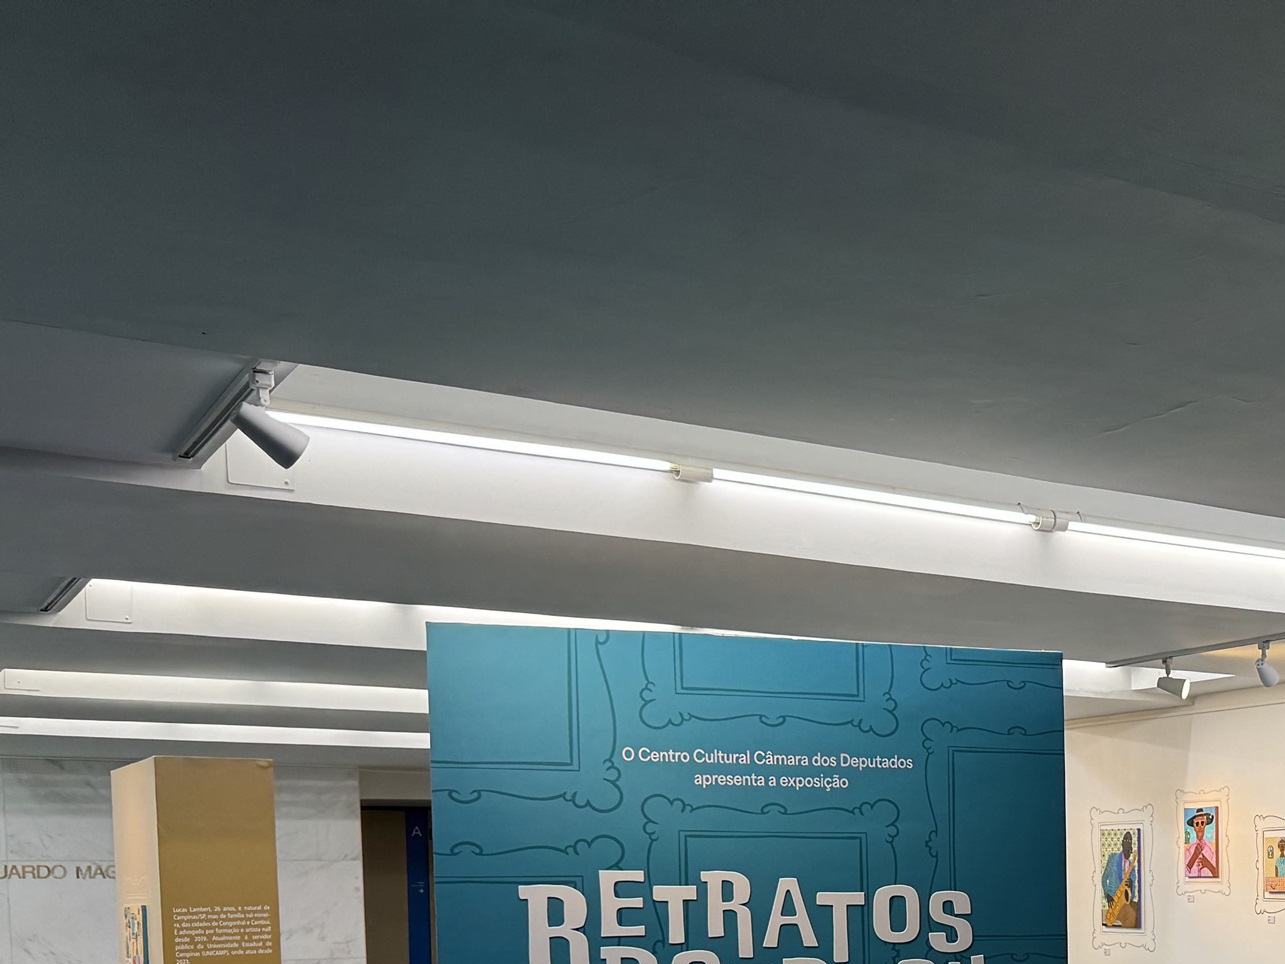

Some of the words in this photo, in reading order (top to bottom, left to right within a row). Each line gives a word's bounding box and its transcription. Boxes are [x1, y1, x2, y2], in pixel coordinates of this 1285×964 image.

[621, 746, 635, 762] O
[638, 747, 690, 763] Centro
[693, 748, 751, 765] Cultural
[753, 750, 809, 766] Câmara
[812, 752, 837, 767] dos
[840, 753, 913, 771] Deputados
[694, 773, 765, 788] apresenta
[768, 775, 777, 787] a
[780, 773, 849, 792] exposição
[411, 825, 423, 837] A
